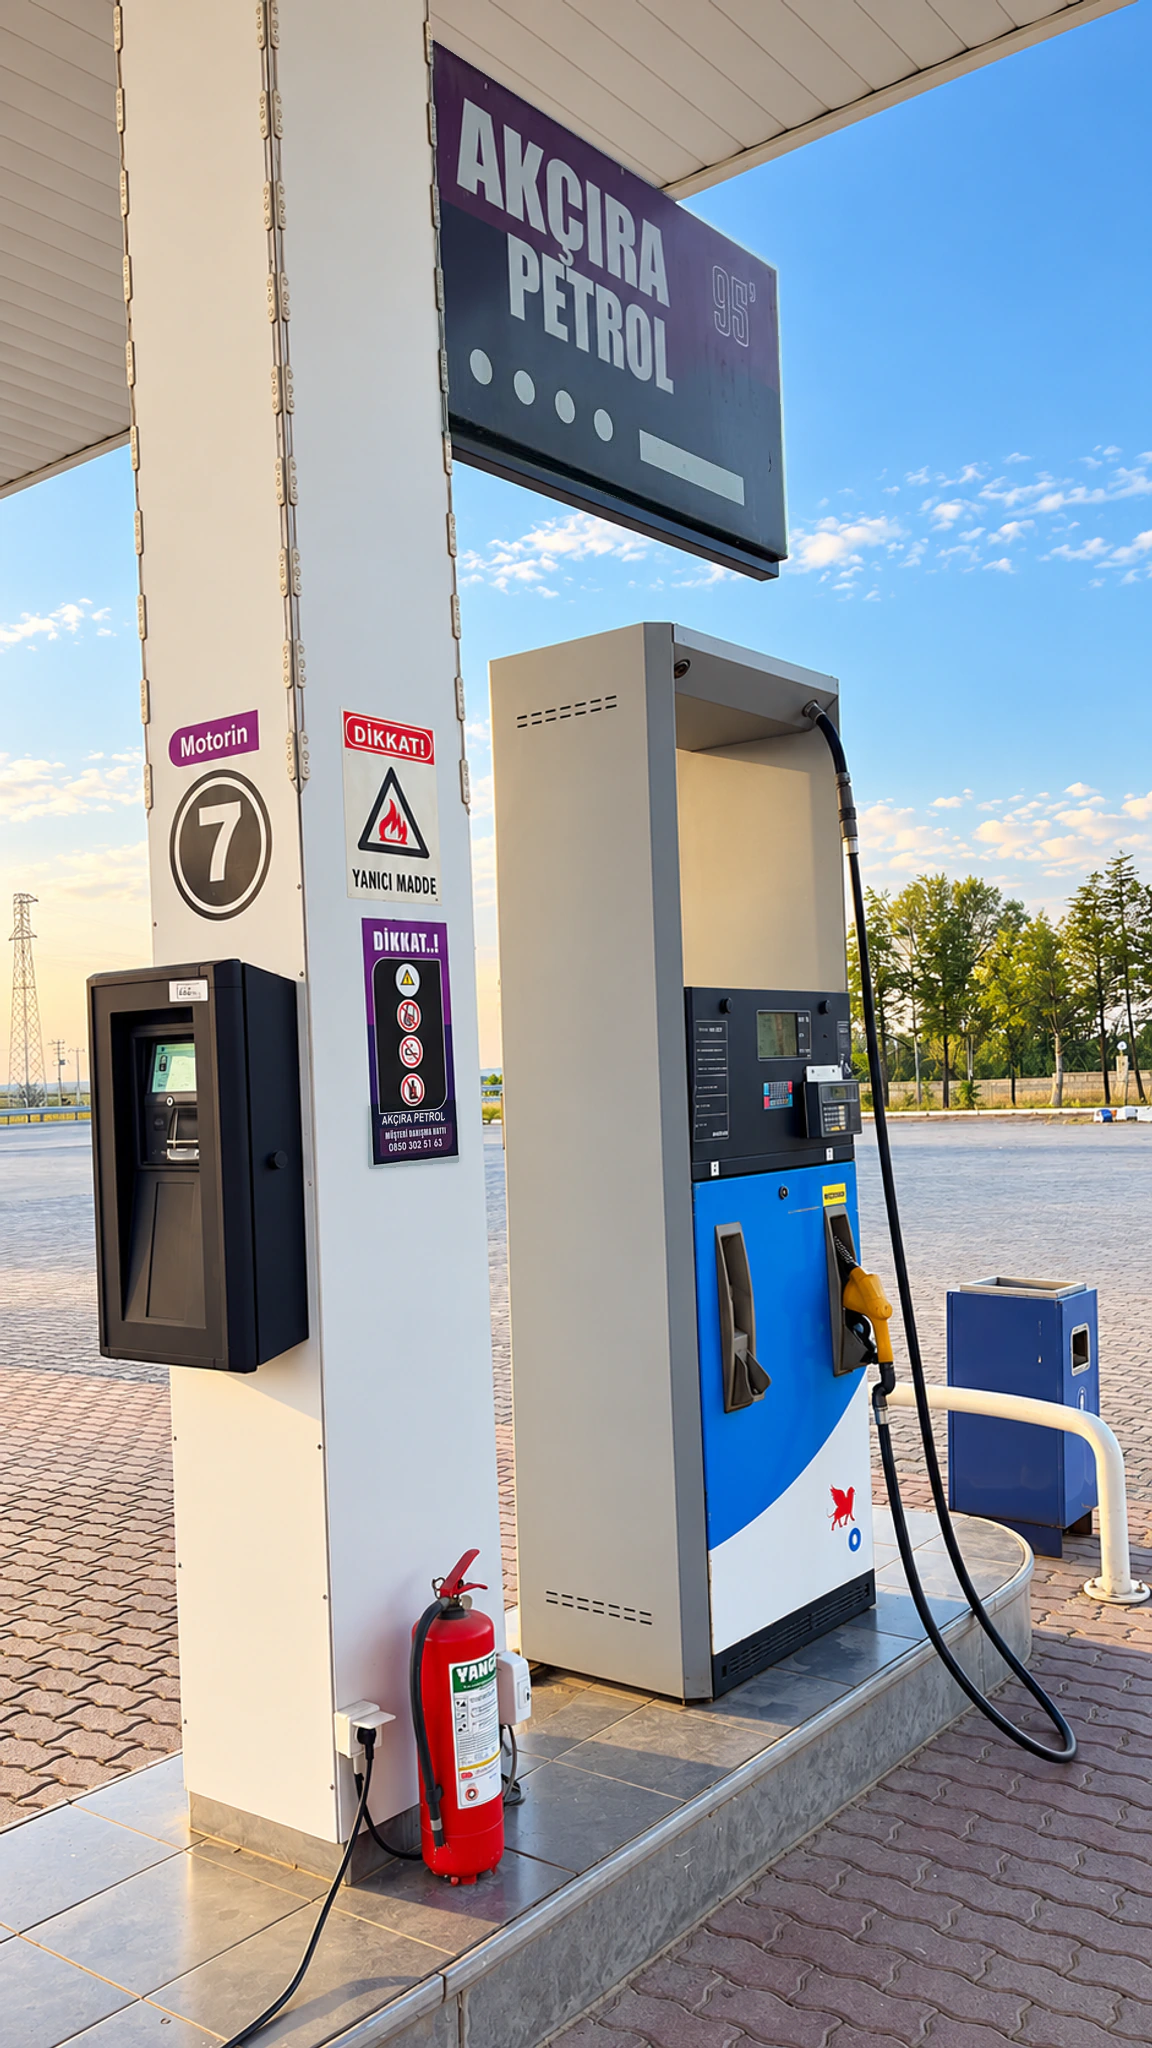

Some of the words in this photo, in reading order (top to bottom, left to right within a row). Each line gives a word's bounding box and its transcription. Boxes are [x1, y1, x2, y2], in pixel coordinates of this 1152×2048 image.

[456, 97, 671, 308] AKÇIRA
[506, 231, 675, 395] PETROL
[180, 723, 248, 758] Motorin
[353, 723, 426, 757] DİKKAT!
[198, 800, 242, 882] 7
[352, 868, 393, 891] YANICI
[396, 872, 437, 895] MADDE
[373, 927, 439, 953] DİKKAT..!
[382, 1114, 412, 1126] AKÇIRA
[414, 1112, 445, 1123] PETROL
[388, 1142, 406, 1152] 0850
[409, 1140, 421, 1149] 302
[423, 1139, 431, 1148] 51
[434, 1138, 443, 1147] 63
